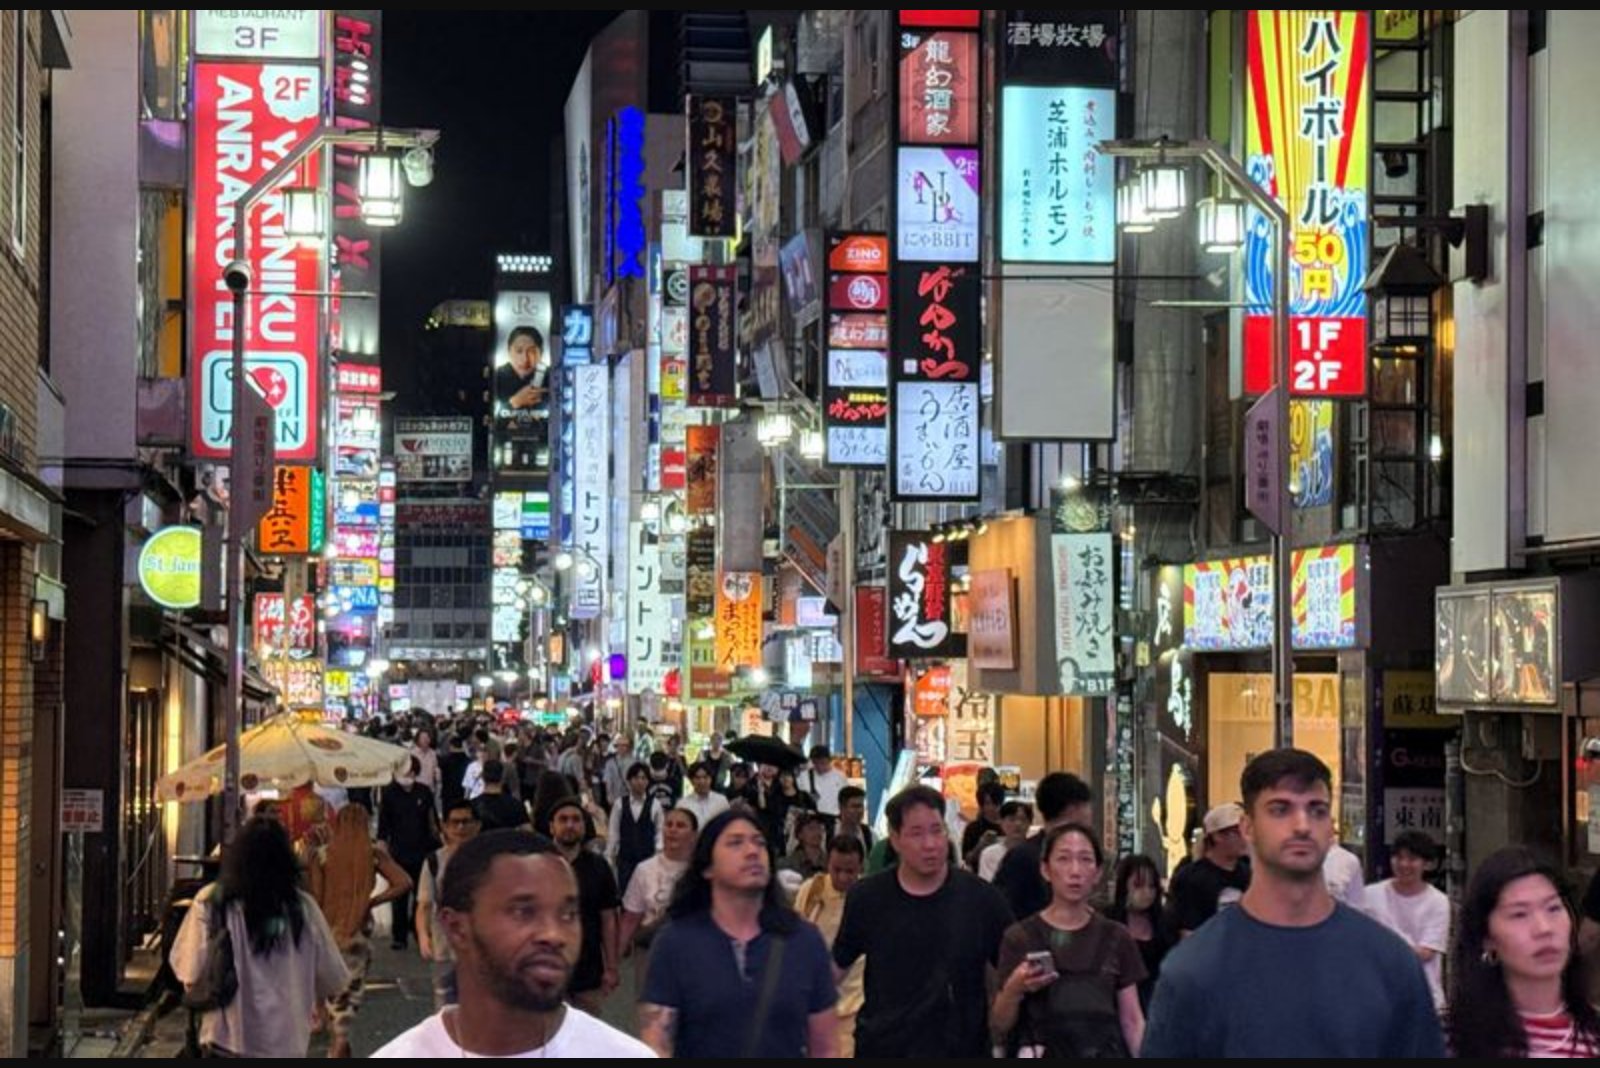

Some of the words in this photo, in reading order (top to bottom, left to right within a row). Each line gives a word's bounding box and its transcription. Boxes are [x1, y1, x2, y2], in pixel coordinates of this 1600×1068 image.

[235, 26, 279, 50] 3F
[275, 78, 311, 100] 2F
[1302, 21, 1341, 224] ハイボール
[955, 157, 977, 176] 2F
[1047, 99, 1069, 246] 芝浦ホルモン
[1302, 268, 1333, 299] 円
[210, 419, 299, 443] JAN
[944, 384, 974, 471] 居酒屋
[636, 530, 652, 661] トントン
[1074, 544, 1110, 659] お好み焼き
